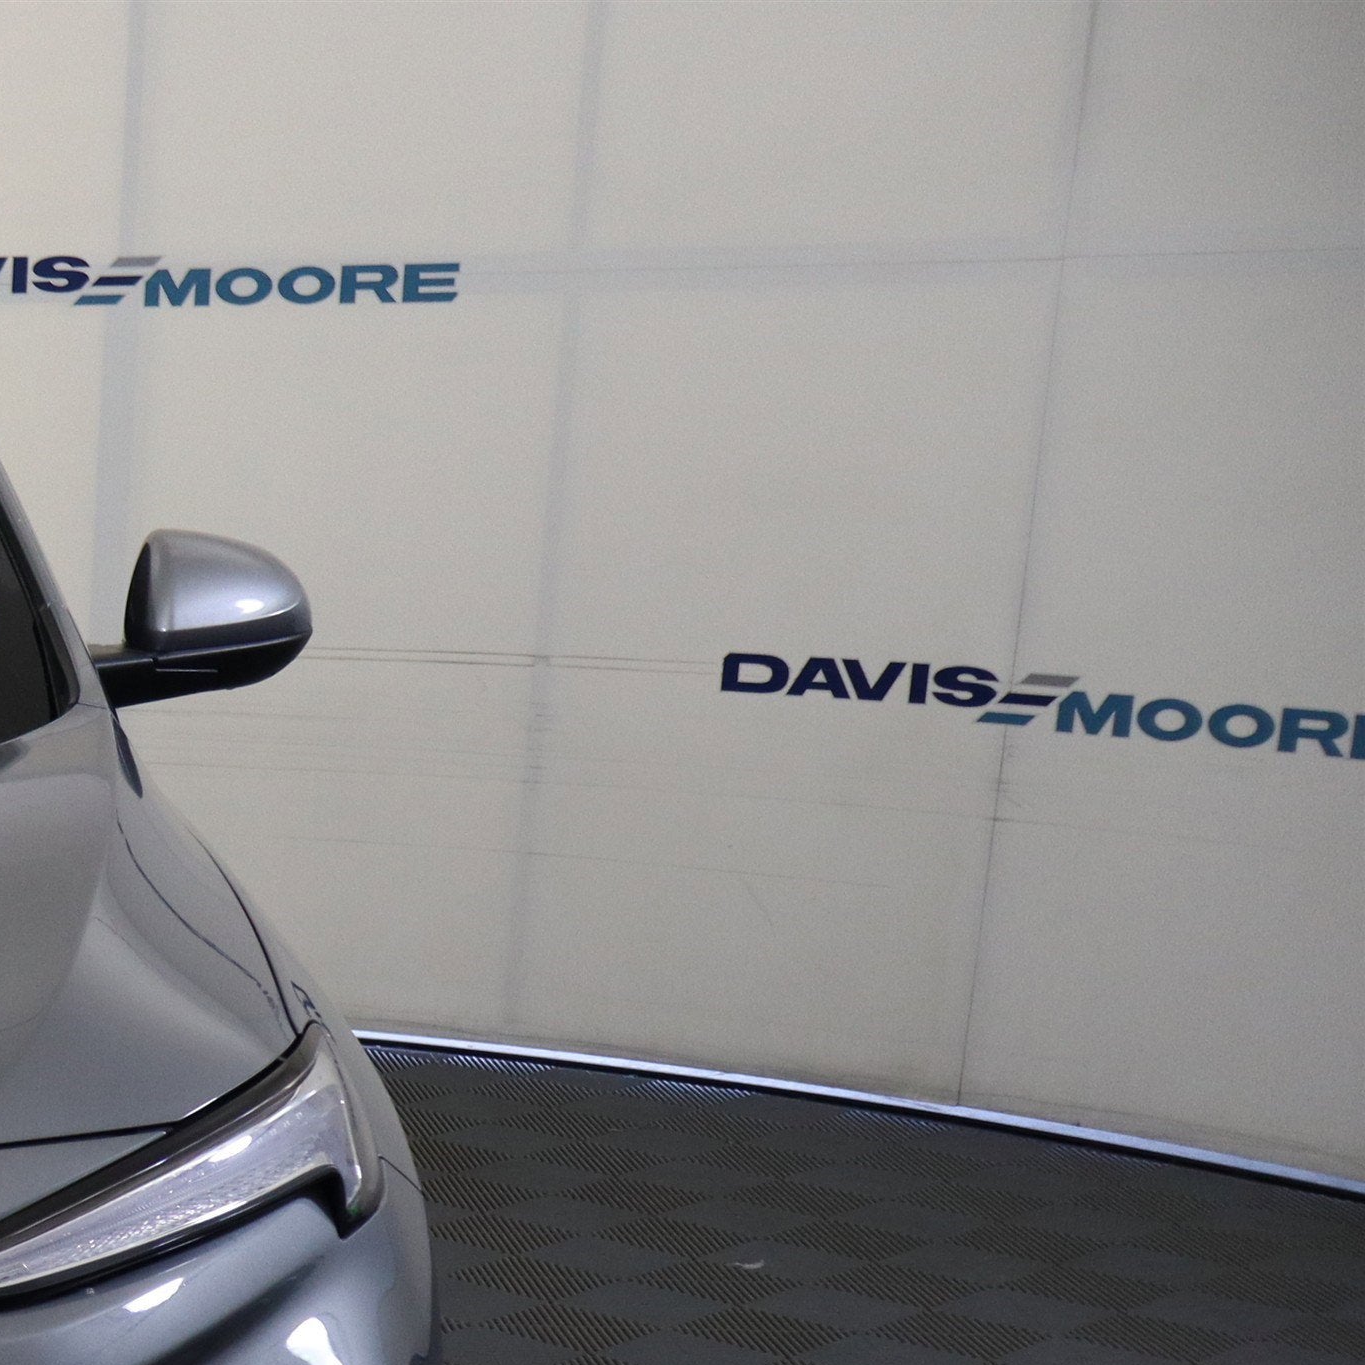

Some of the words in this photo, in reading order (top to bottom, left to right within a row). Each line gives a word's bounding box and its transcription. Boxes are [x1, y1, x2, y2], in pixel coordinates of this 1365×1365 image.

[143, 262, 461, 308] MOORE
[720, 652, 999, 708] DAVIS
[1055, 690, 1365, 760] MOOR
